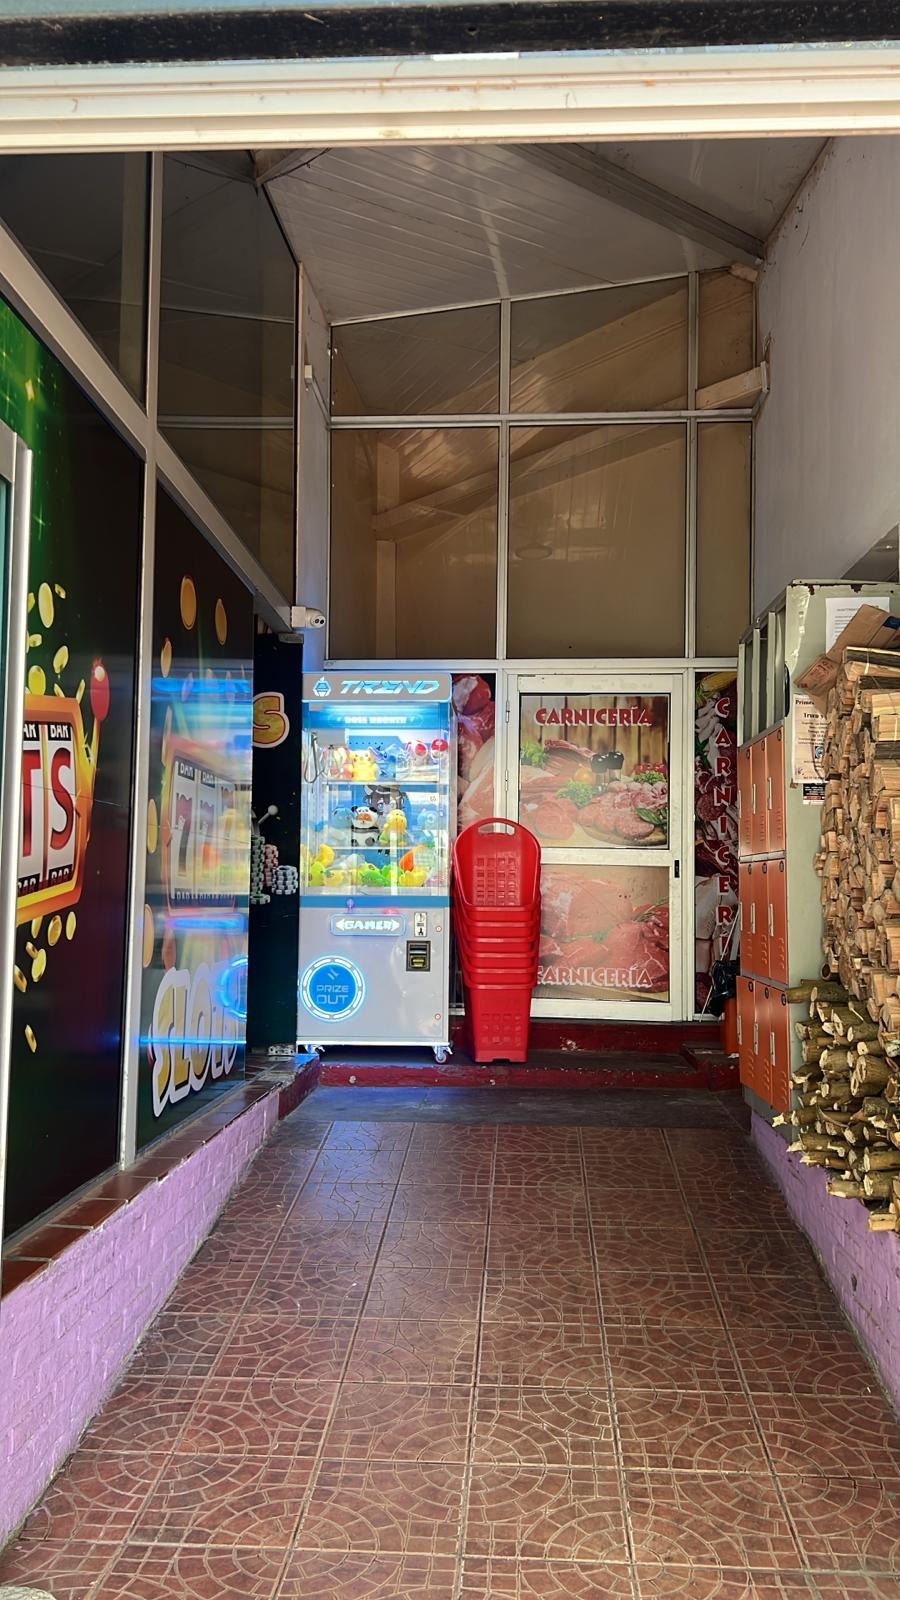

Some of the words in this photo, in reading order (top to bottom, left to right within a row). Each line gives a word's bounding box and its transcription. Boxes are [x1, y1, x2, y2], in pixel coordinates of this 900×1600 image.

[340, 680, 440, 694] TREND
[535, 706, 652, 726] CARNICERÍA
[714, 697, 732, 956] CARNICERÍ
[345, 920, 391, 930] GAMER
[316, 985, 349, 993] PRIZE
[316, 995, 349, 1004] OUT
